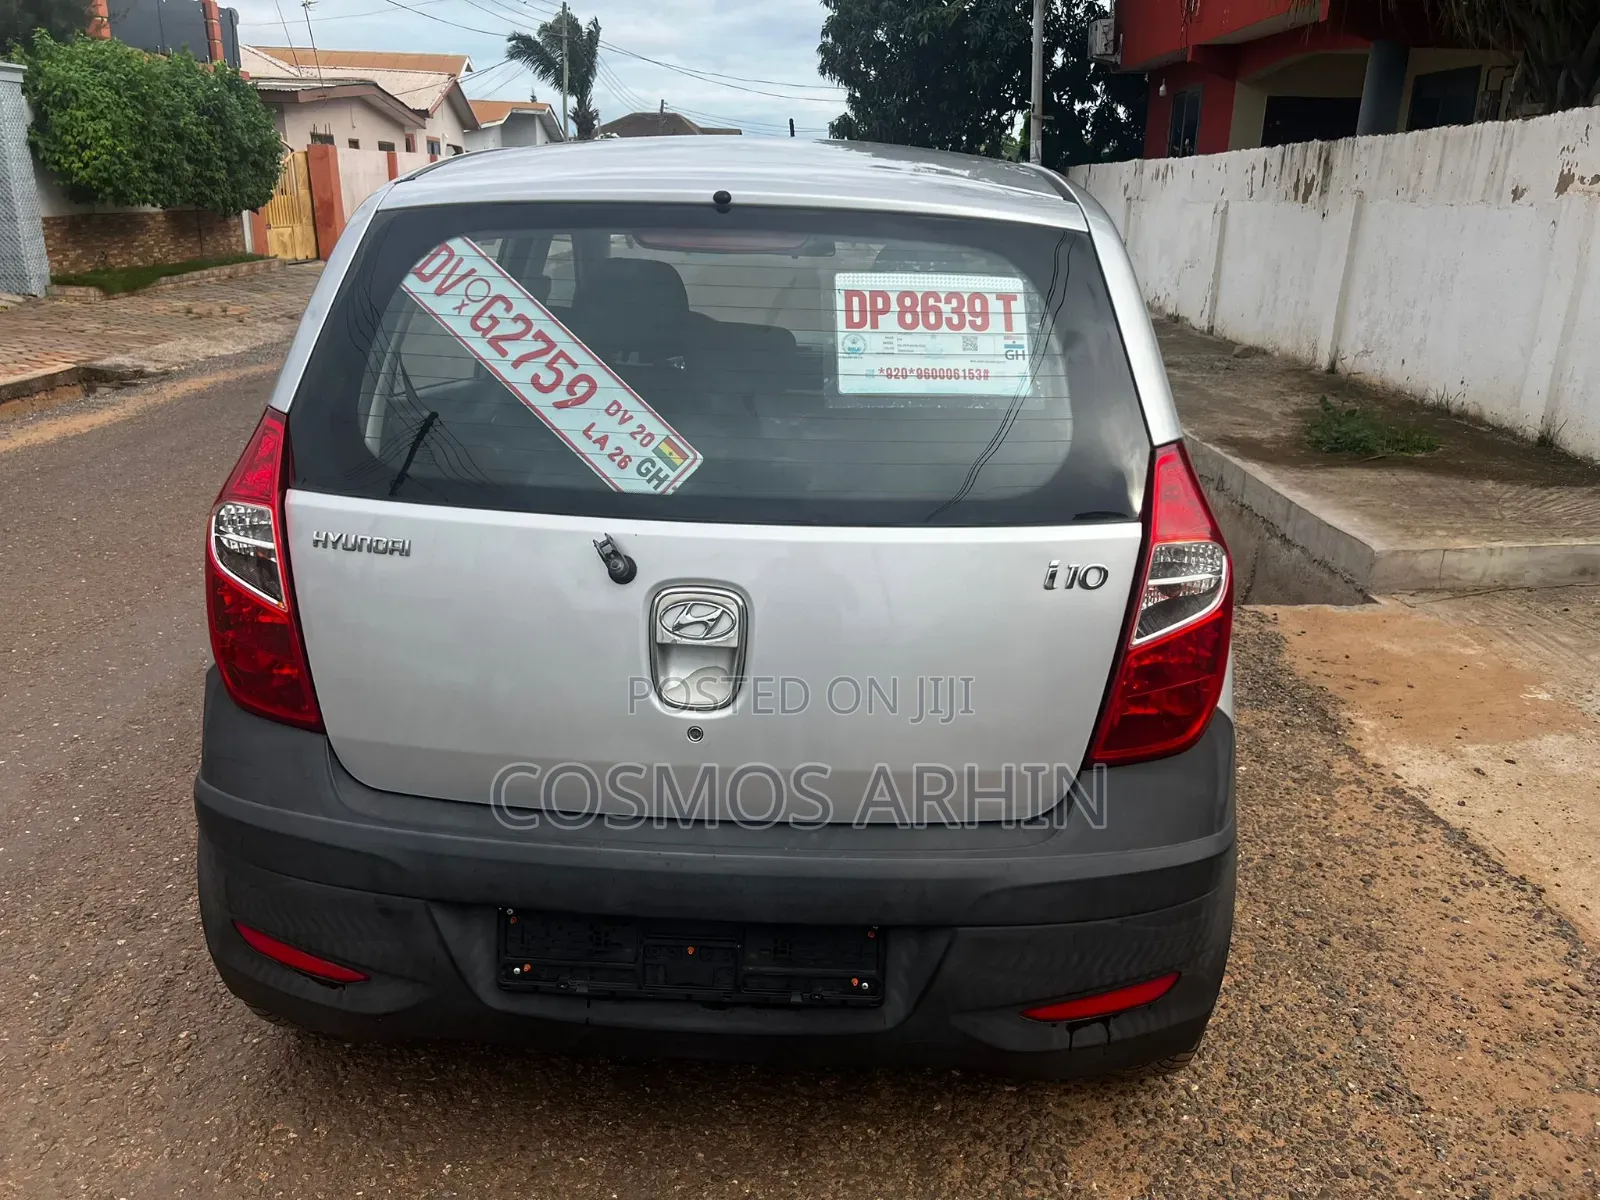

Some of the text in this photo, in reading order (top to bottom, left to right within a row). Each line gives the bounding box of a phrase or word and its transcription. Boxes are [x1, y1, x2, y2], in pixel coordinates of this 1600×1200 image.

[412, 241, 598, 410] DV G2759
[844, 289, 1018, 332] DP 8639 T
[1004, 349, 1026, 361] GH
[604, 399, 656, 448] DV 20
[582, 421, 633, 470] LA 26
[635, 457, 670, 491] GH
[312, 530, 412, 557] HYUNDAI
[1043, 559, 1109, 591] i10
